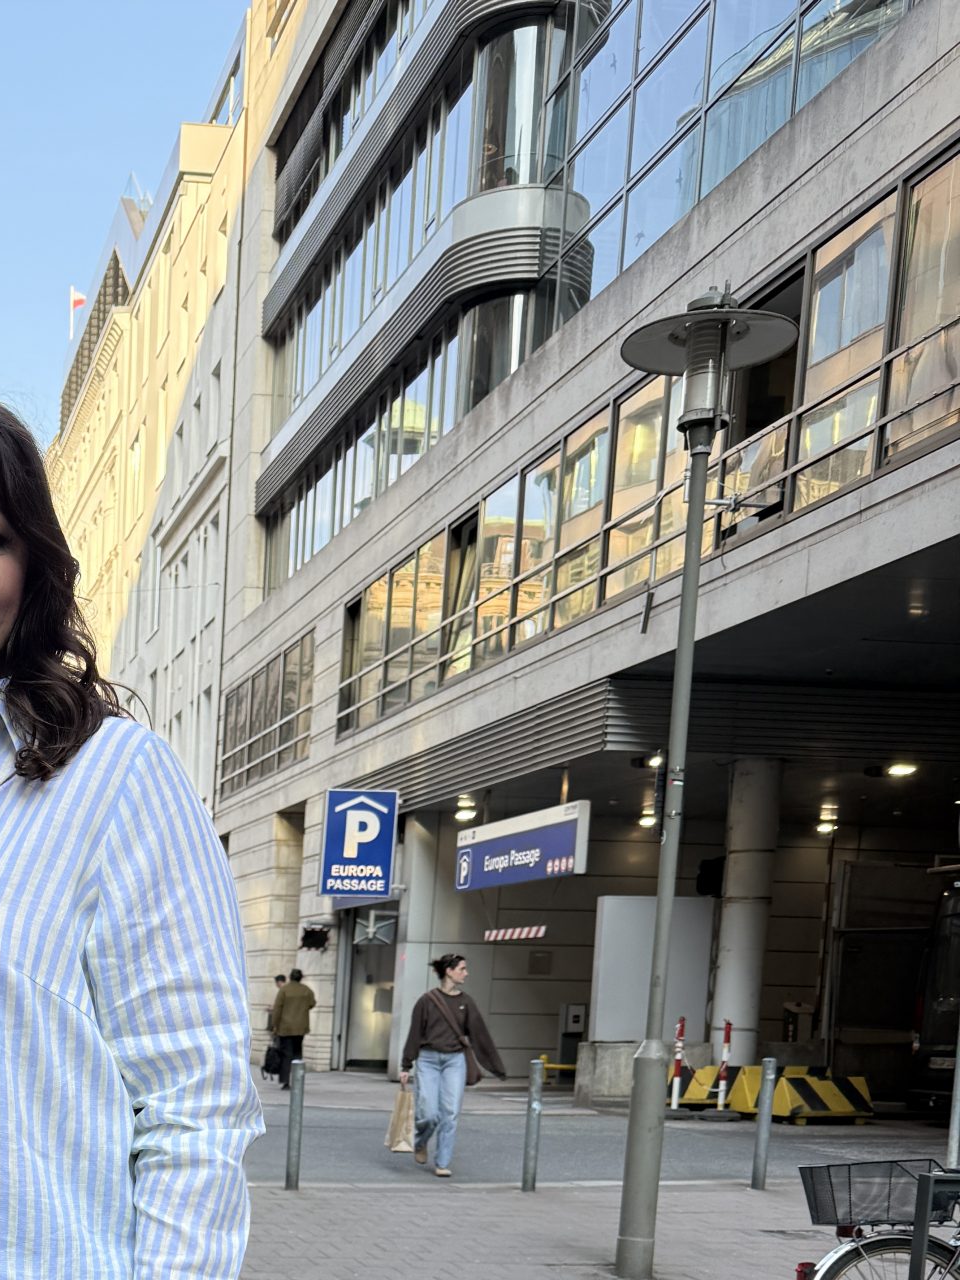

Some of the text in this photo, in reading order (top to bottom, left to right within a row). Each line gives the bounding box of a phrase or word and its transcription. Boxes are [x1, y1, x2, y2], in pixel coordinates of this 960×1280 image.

[343, 810, 380, 858] P
[484, 848, 541, 872] Europa Passage
[331, 864, 383, 877] EUROPA
[326, 878, 385, 891] PASSAGE
